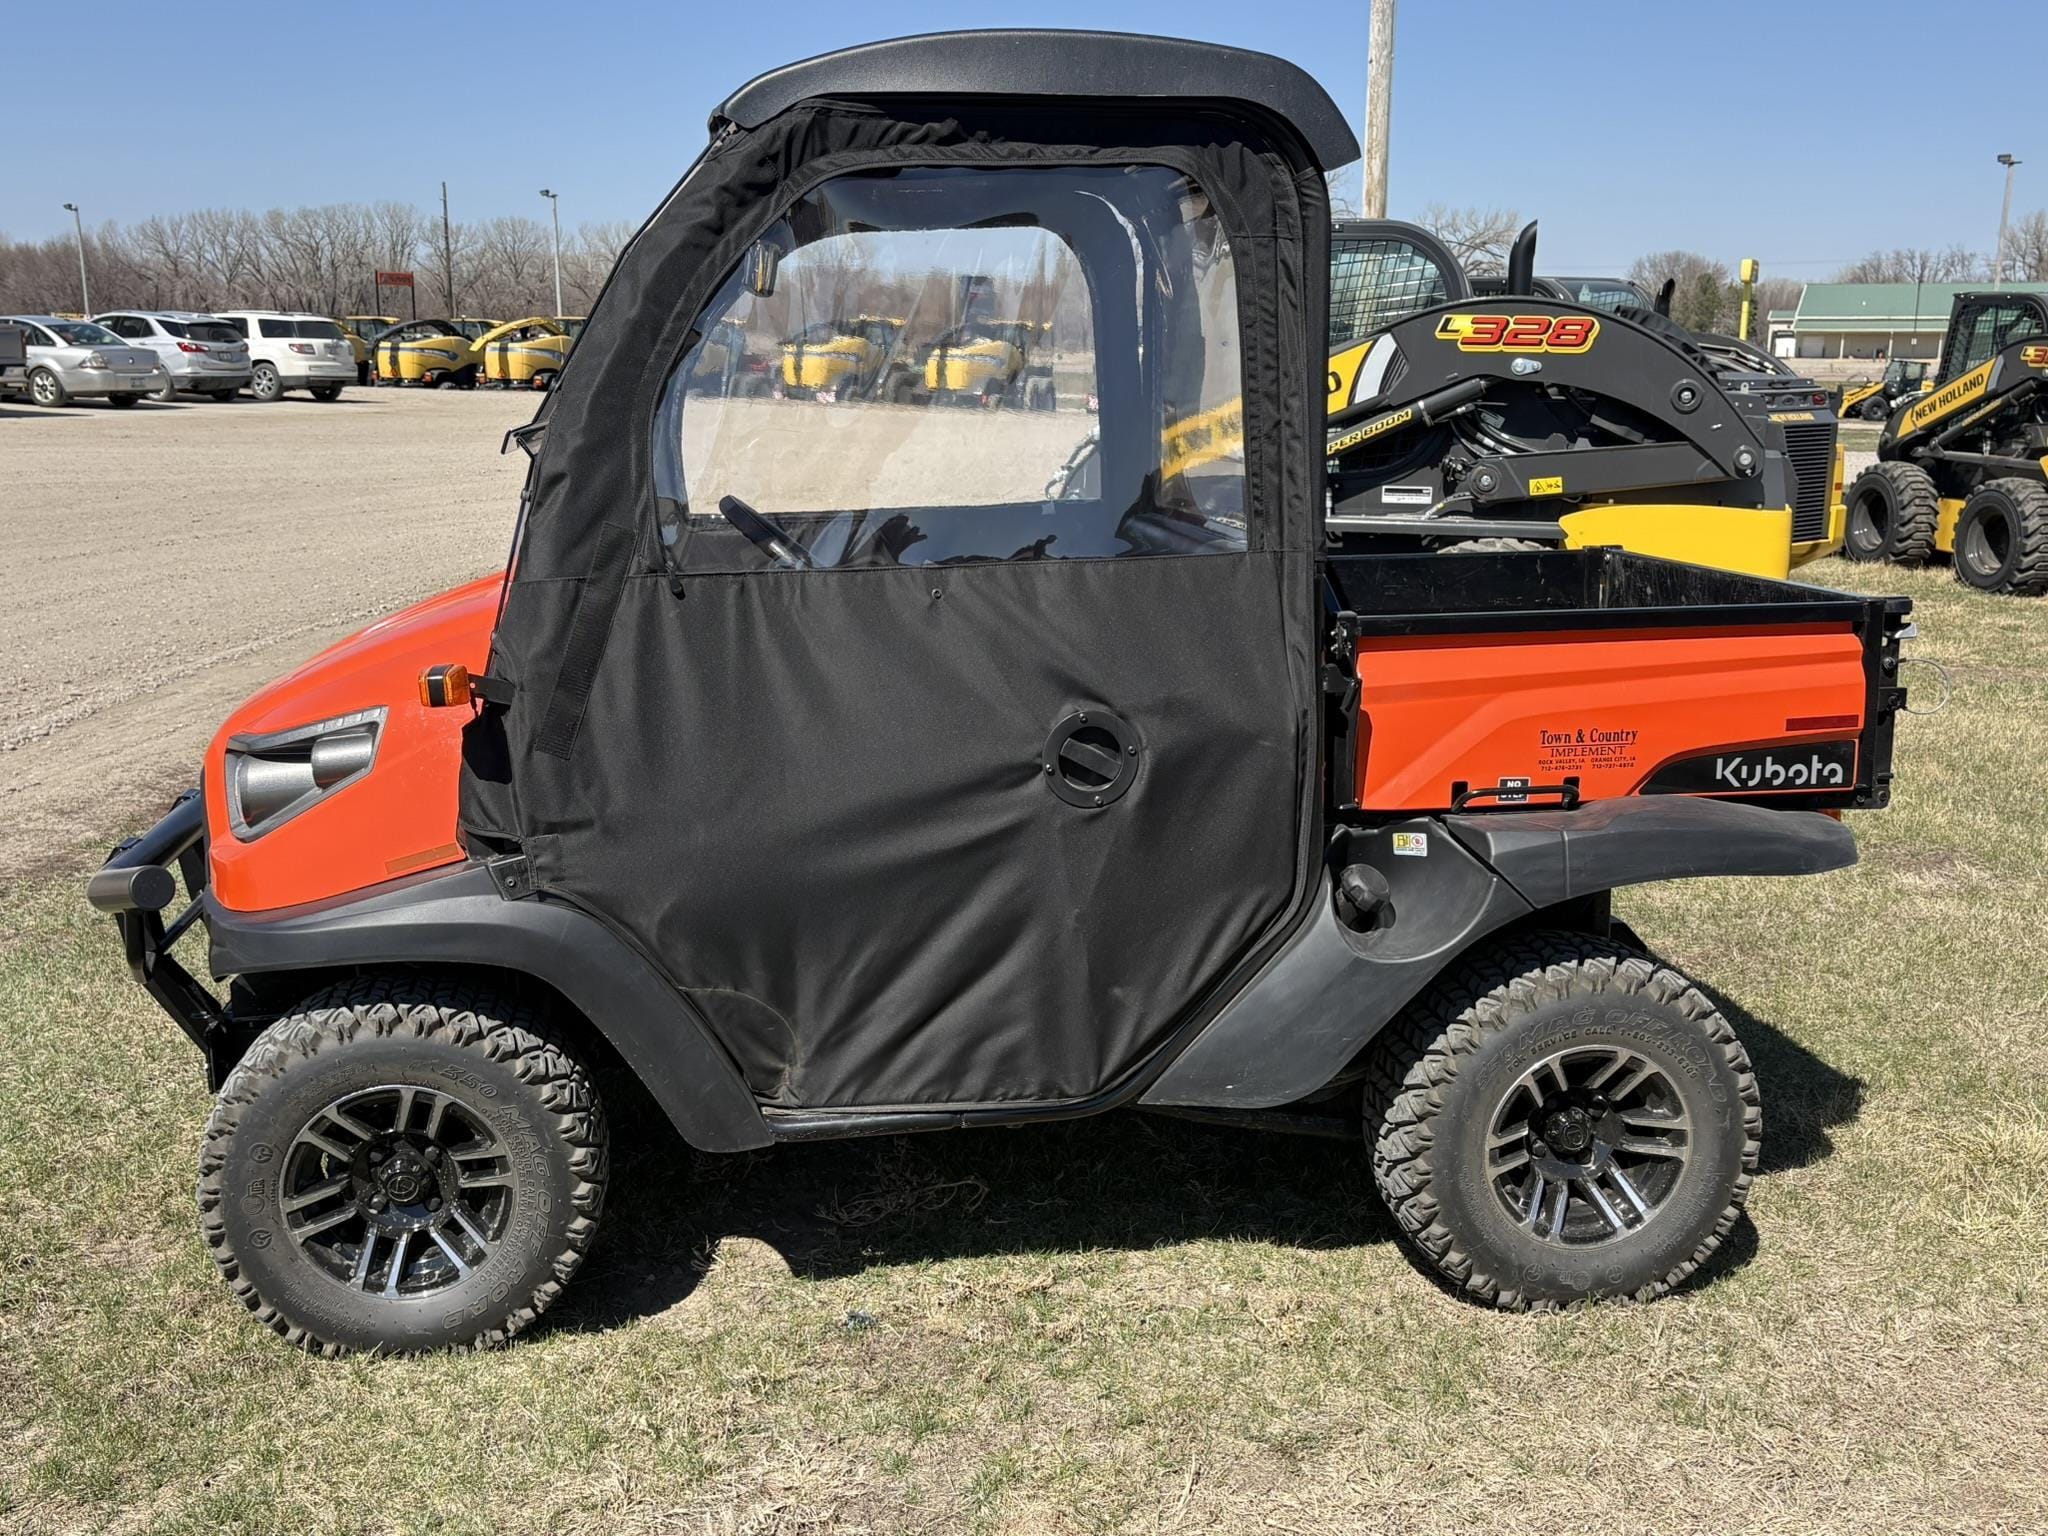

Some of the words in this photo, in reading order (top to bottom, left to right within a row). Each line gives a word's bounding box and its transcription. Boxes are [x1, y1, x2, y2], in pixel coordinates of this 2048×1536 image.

[1436, 315, 1600, 352] L328
[2021, 346, 2048, 367] L3
[1915, 400, 1937, 421] NEW
[1938, 373, 1985, 408] HOLLAND
[1327, 431, 1361, 455] PER
[1362, 408, 1412, 438] BOOM
[1540, 730, 1571, 745] Town
[1576, 729, 1585, 743] &
[1590, 728, 1638, 746] Country
[1551, 746, 1626, 757] IMPLEMENT
[1507, 780, 1521, 788] NO
[1716, 755, 1843, 787] Kubota
[1519, 1009, 1597, 1051] MAG
[440, 1064, 498, 1099] 350
[500, 1104, 551, 1177] MAG
[530, 1190, 553, 1258] OFF
[442, 1260, 528, 1329] ROAD
